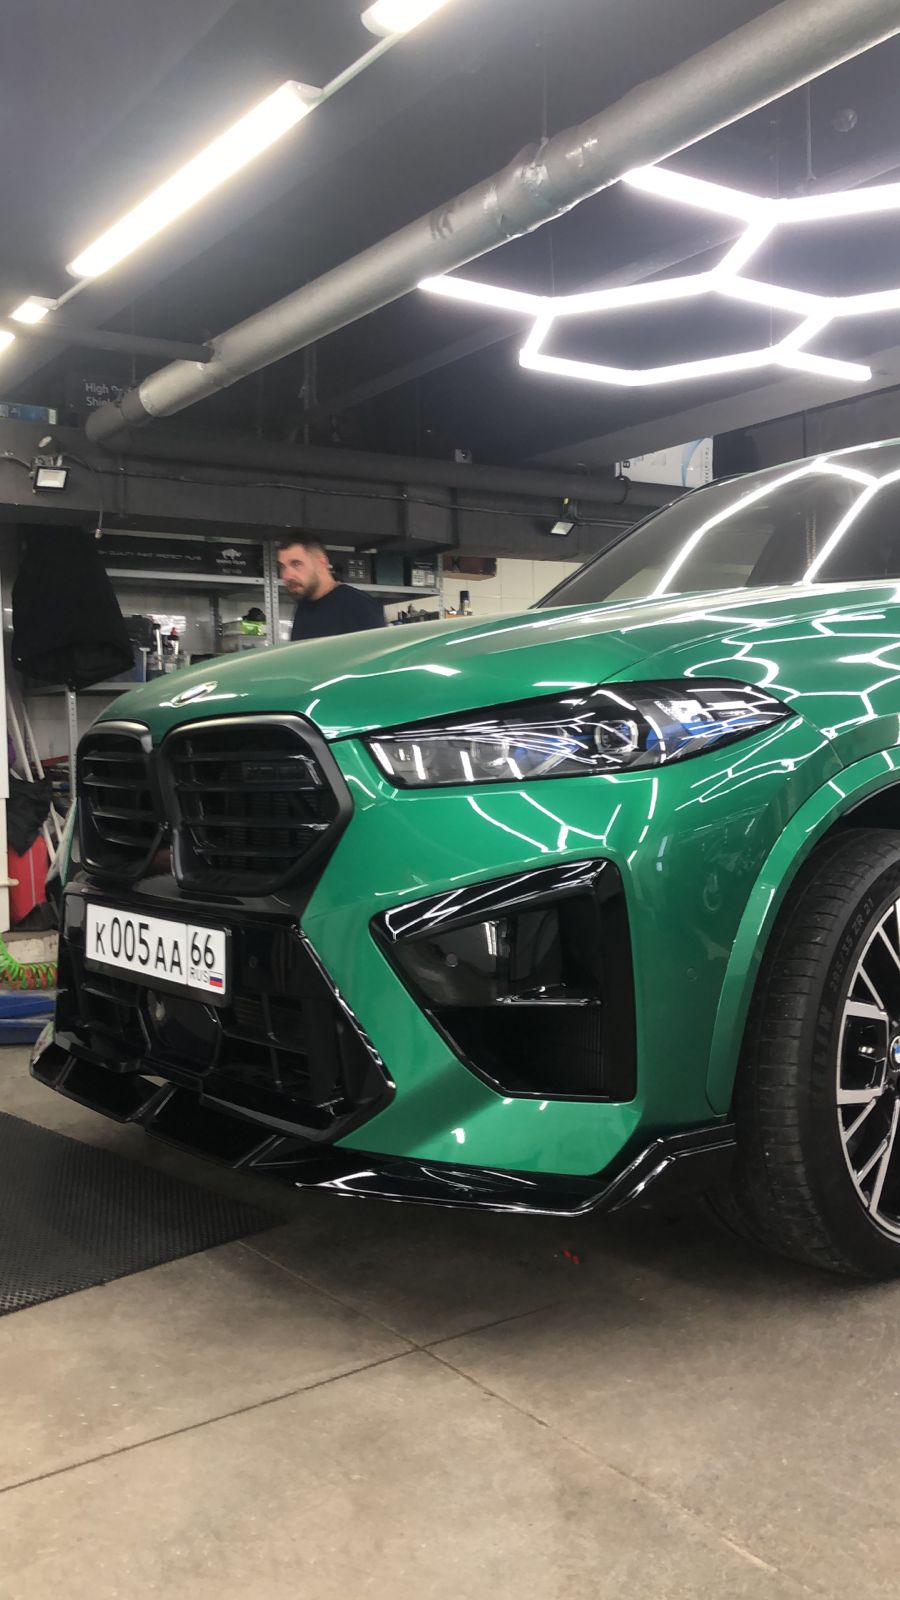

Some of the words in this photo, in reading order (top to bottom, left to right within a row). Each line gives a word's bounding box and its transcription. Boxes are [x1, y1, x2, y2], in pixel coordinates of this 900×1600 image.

[85, 382, 109, 396] High
[864, 897, 875, 915] 21
[190, 931, 215, 969] 66
[189, 967, 209, 984] RUS
